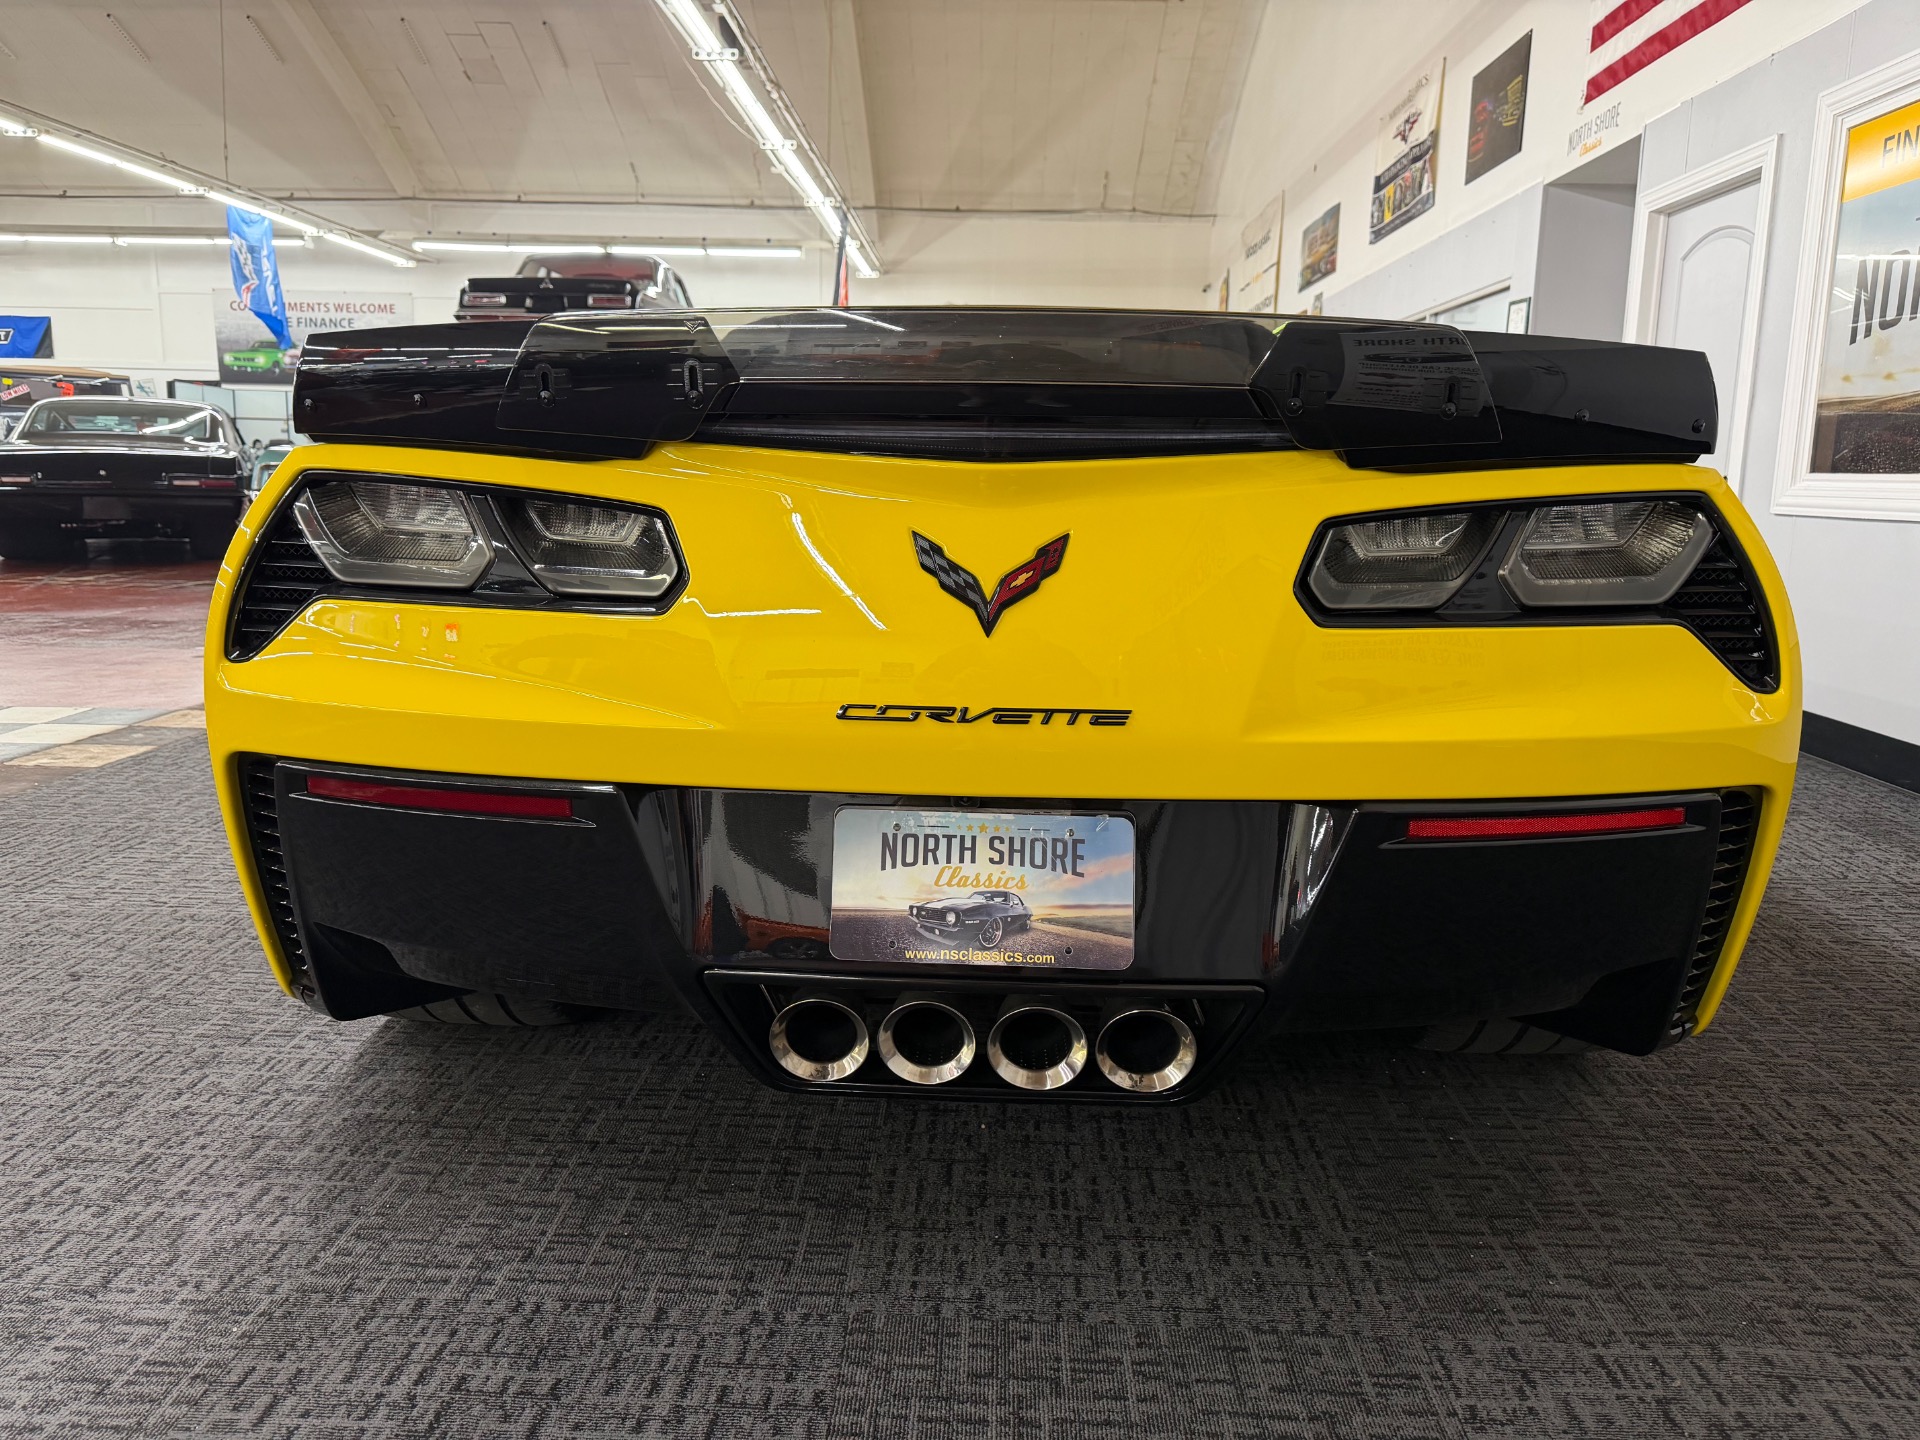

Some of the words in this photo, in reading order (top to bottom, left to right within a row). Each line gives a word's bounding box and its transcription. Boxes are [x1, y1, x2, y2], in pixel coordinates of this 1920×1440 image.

[1567, 119, 1593, 157] NORTH
[1594, 101, 1621, 134] SHORE
[333, 302, 396, 314] WELCOME
[297, 317, 355, 328] FINANCE
[836, 703, 1133, 726] CORVETTE
[880, 831, 977, 871] NORTH
[988, 835, 1085, 878] SHORE
[933, 865, 1029, 890] Classics
[904, 948, 1055, 964] www.nsclassics.com
